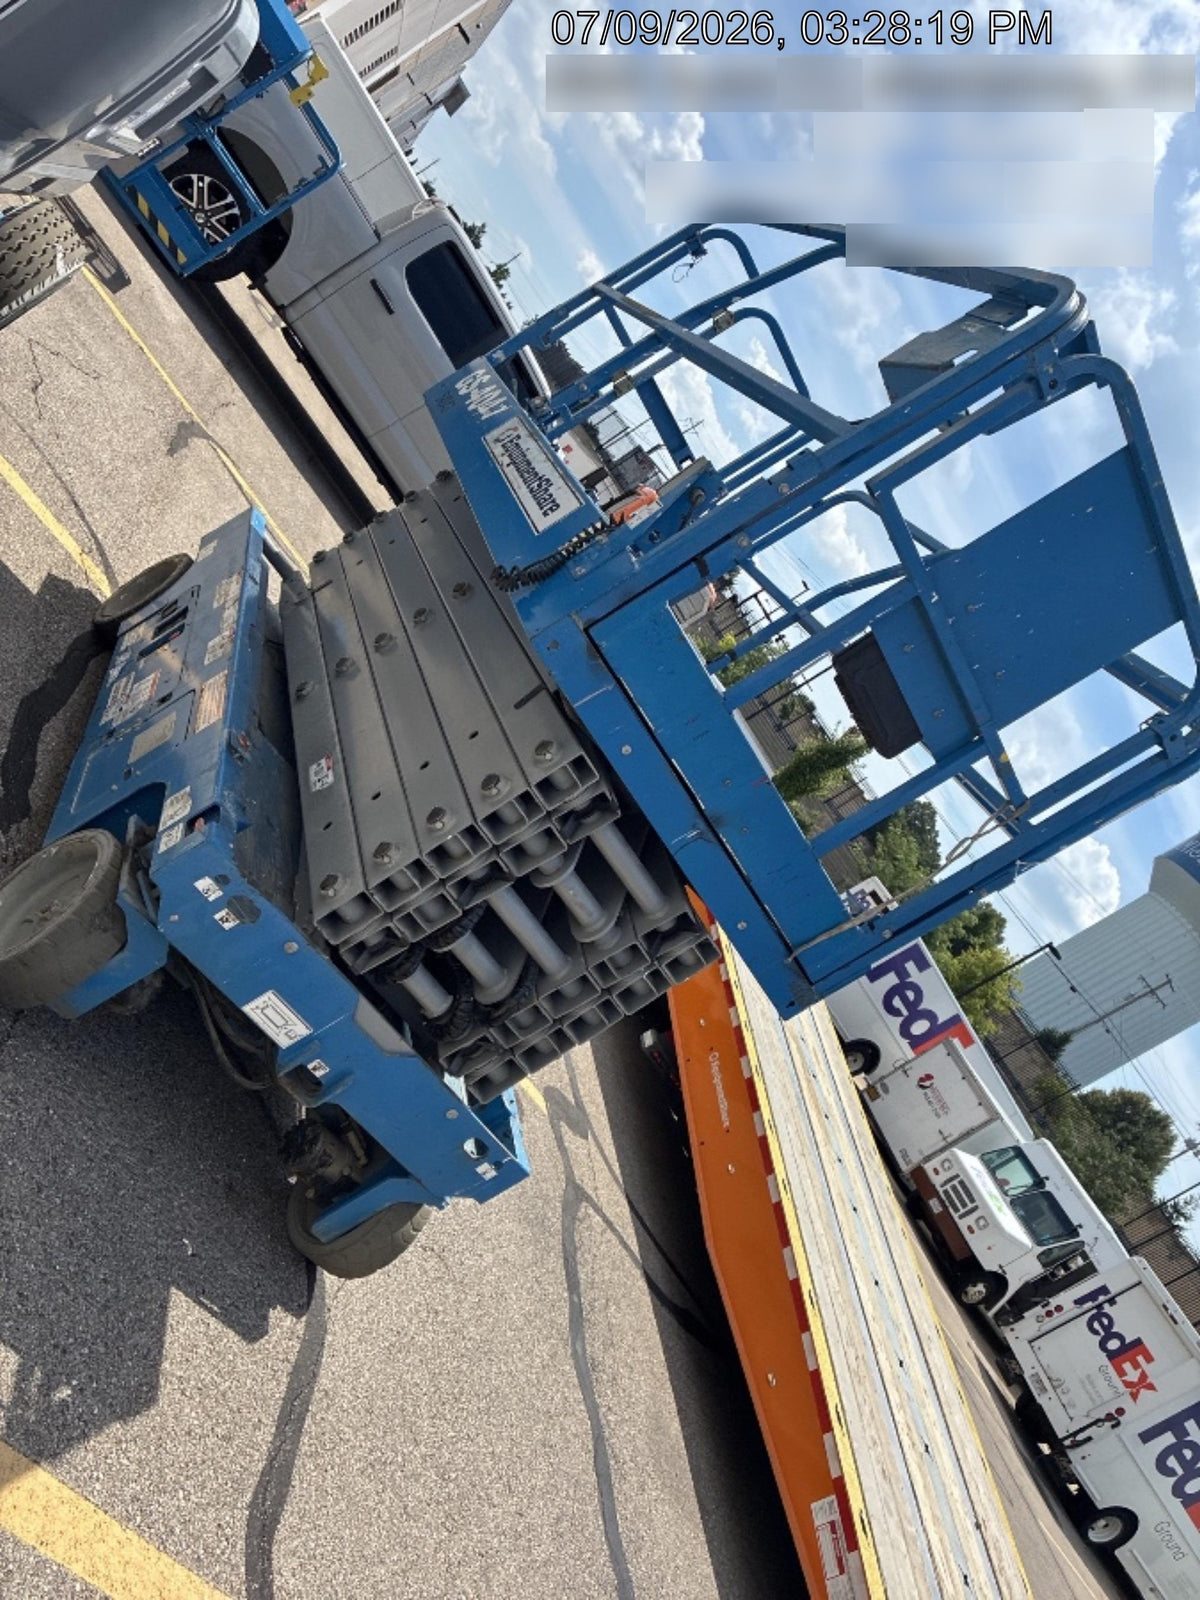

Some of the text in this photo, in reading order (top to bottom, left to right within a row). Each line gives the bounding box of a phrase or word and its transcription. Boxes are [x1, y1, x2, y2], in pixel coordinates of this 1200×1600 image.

[501, 434, 561, 518] EquipmentShare
[865, 943, 977, 1056] Fed
[1073, 1284, 1158, 1405] FedEx
[1154, 1520, 1189, 1562] Ground
